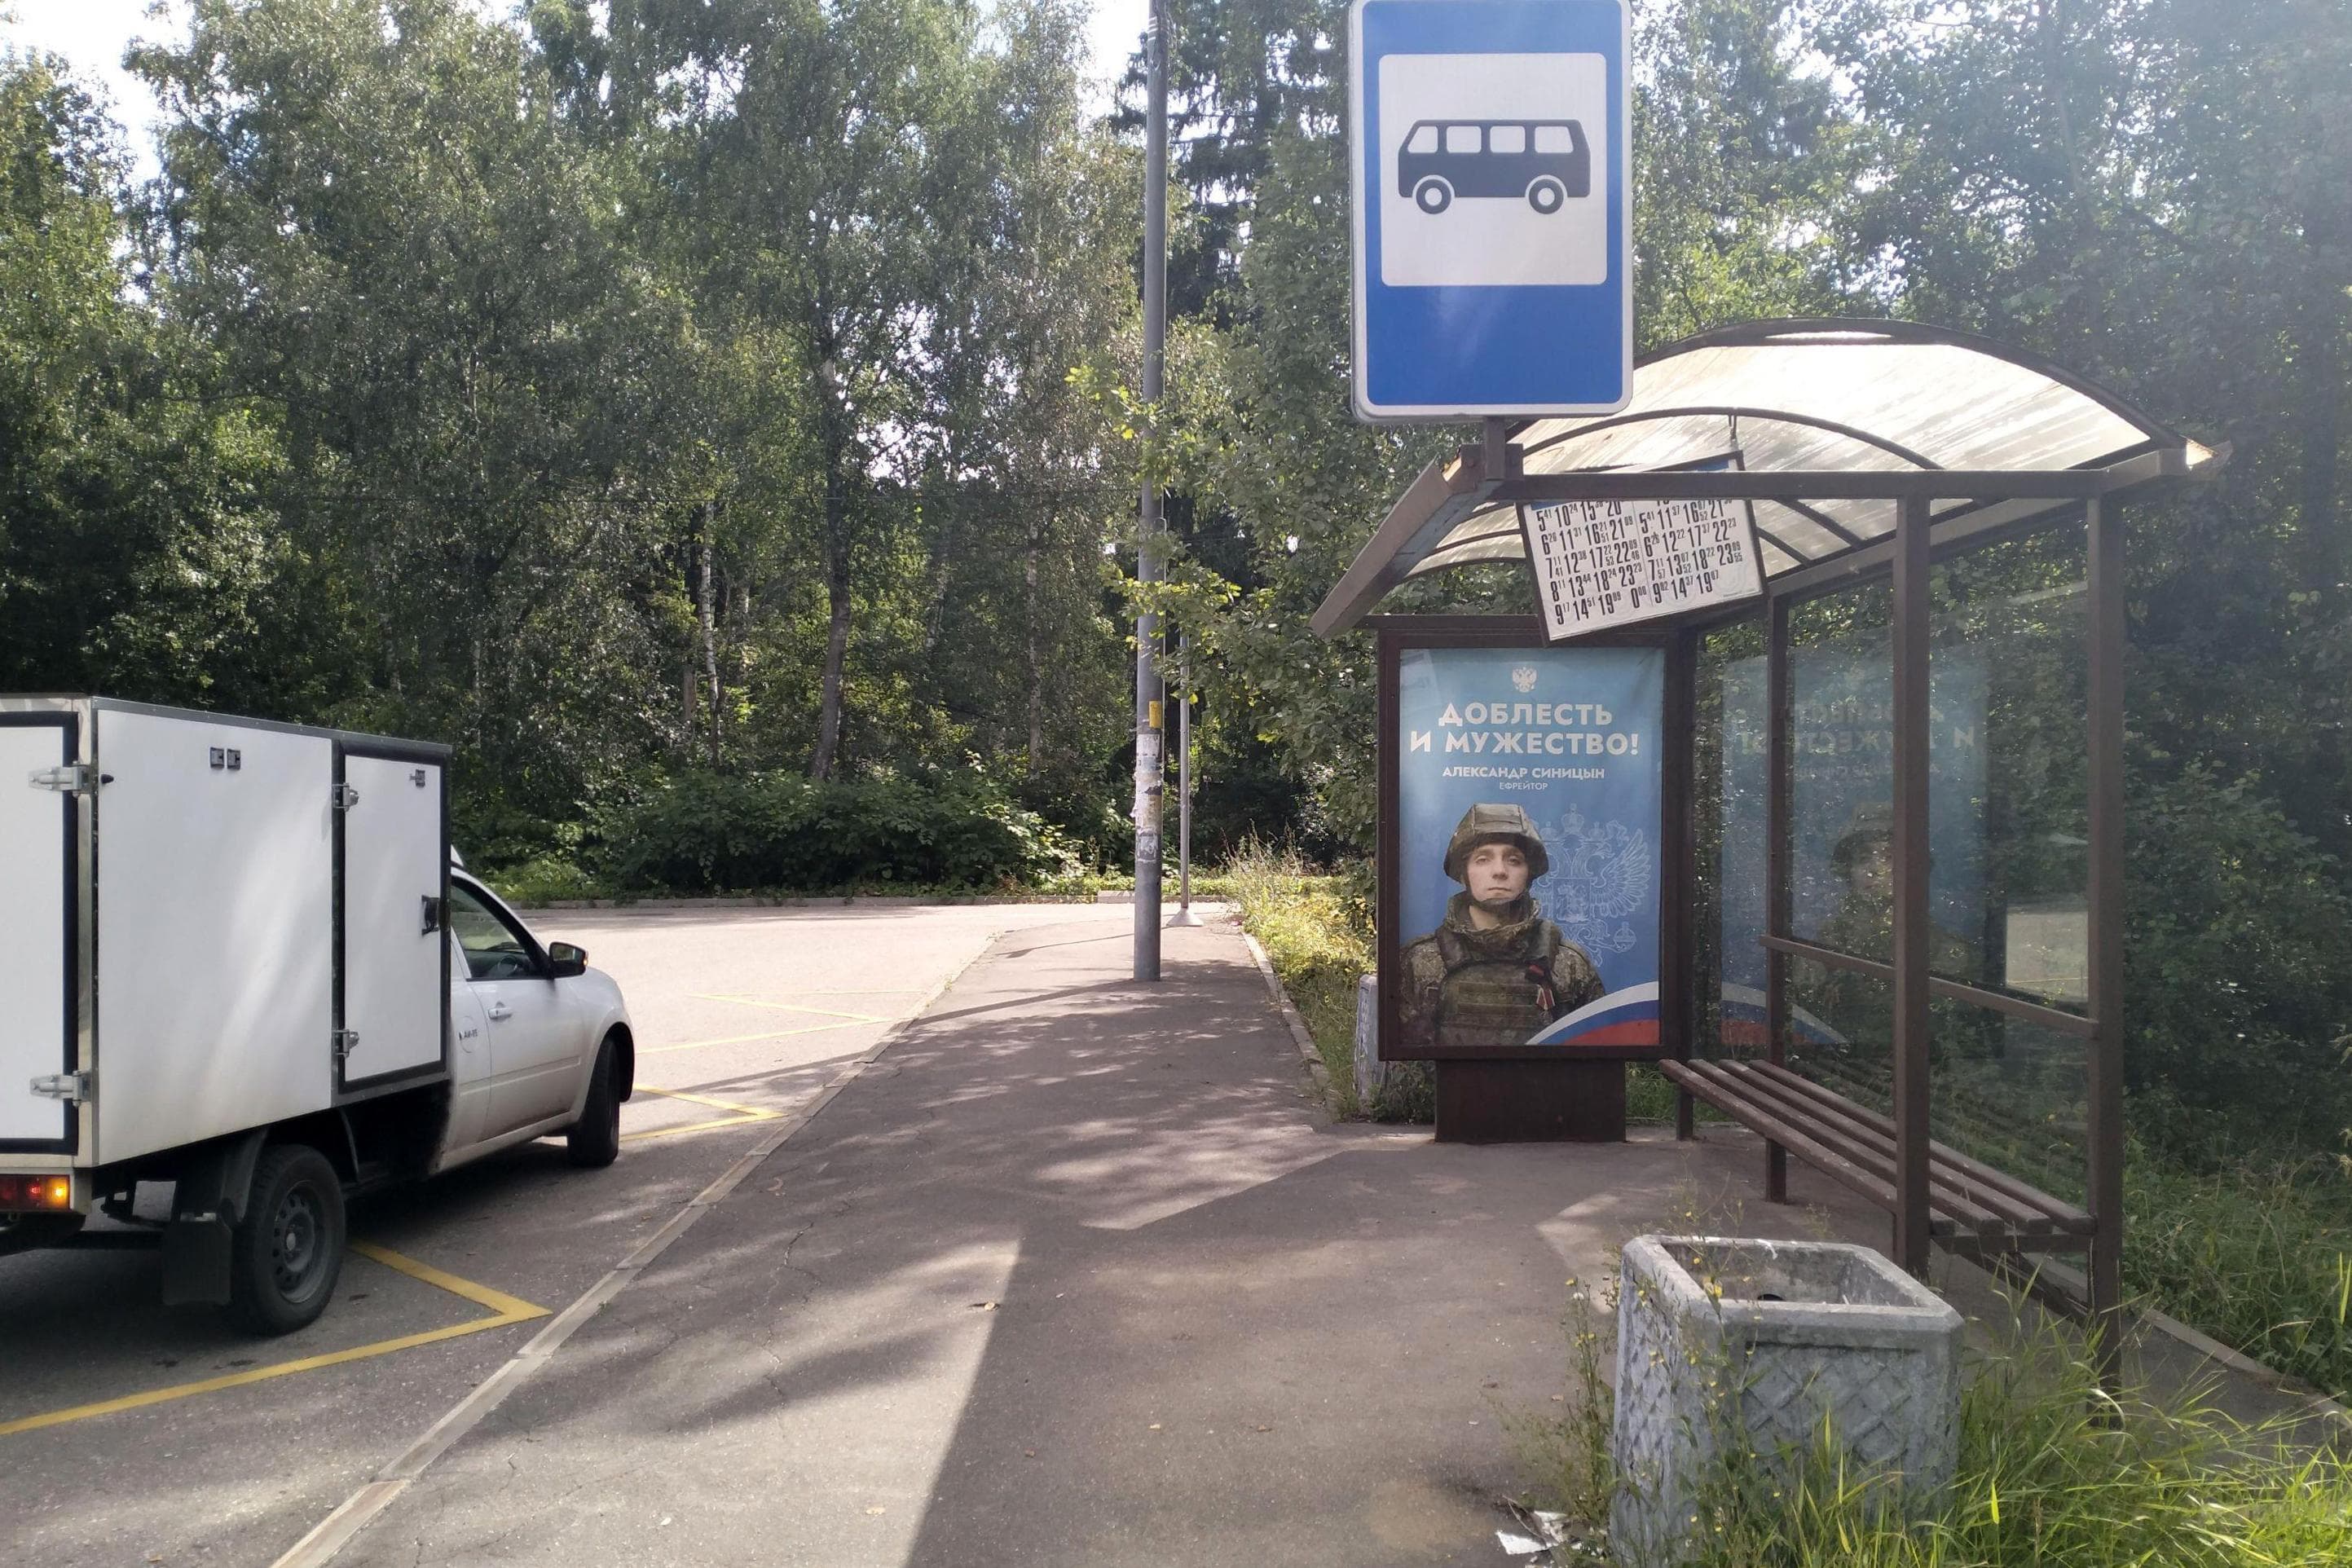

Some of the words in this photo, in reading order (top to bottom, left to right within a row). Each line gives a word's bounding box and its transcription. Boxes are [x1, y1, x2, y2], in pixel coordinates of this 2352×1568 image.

[1438, 703, 1613, 726] ДОБЛЕСТЬ
[1411, 731, 1430, 752] И
[1445, 731, 1639, 755] МУЖЕСТВО!
[1442, 767, 1526, 779] АЛЕКСАНДР
[1532, 767, 1605, 781] СИНИЦЫН
[1500, 780, 1548, 791] ЕФРЕЙТОР
